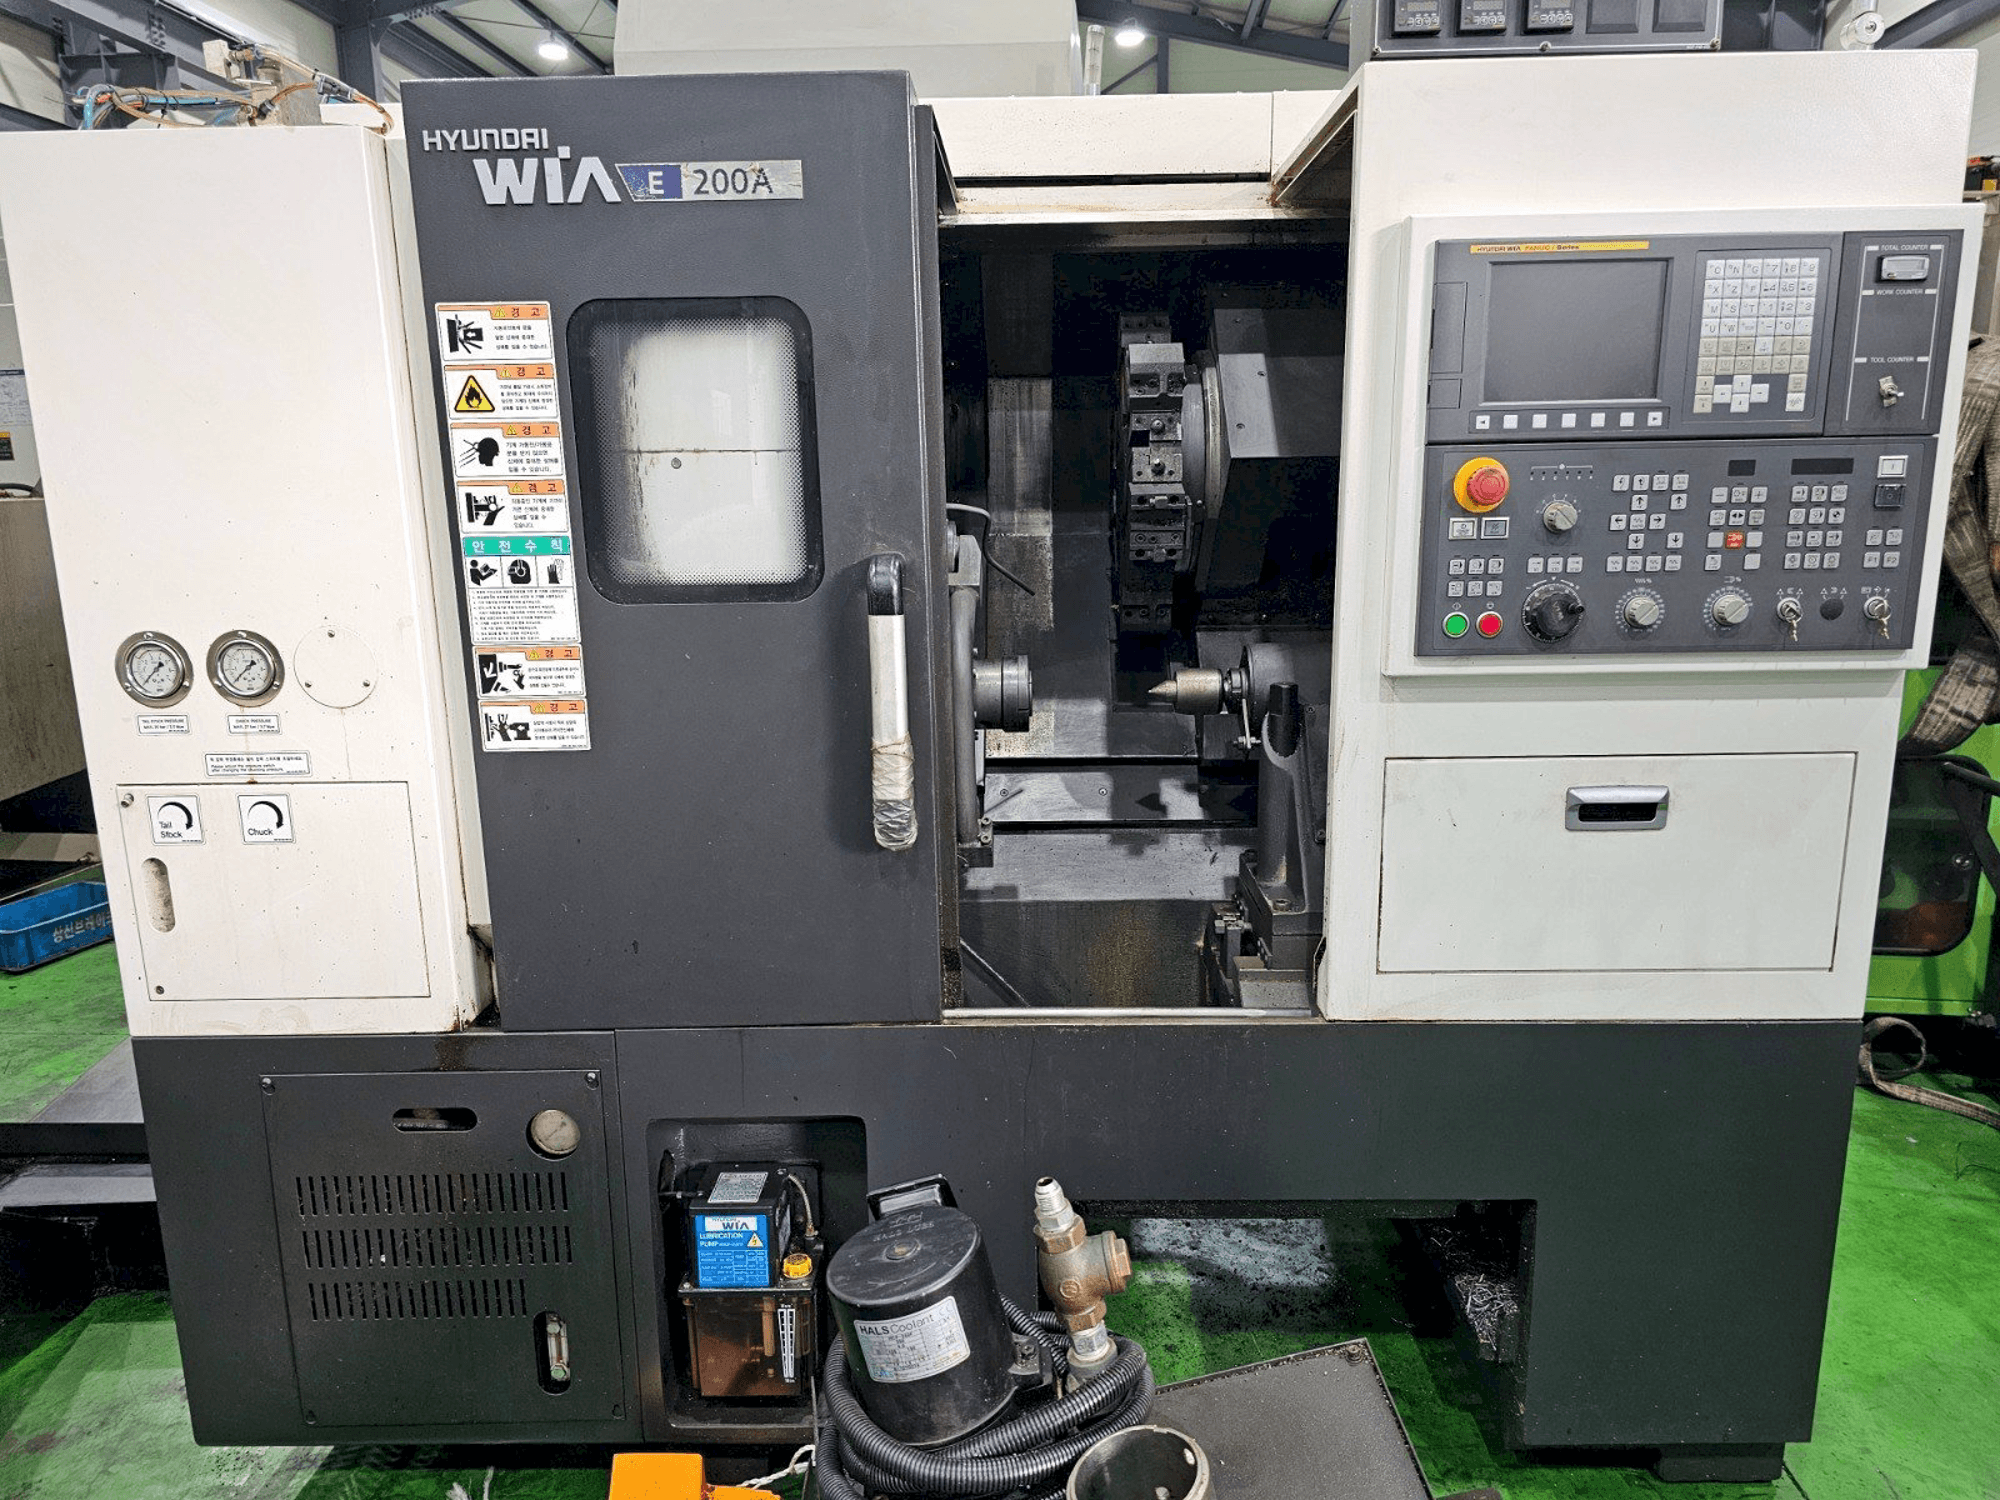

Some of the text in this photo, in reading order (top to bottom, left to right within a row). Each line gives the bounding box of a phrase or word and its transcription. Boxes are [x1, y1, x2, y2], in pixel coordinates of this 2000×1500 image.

[422, 128, 549, 151] HYUNDAI
[472, 145, 622, 205] WIA
[647, 167, 774, 195] E 200A
[158, 821, 172, 829] Tail
[247, 828, 273, 836] Chuck
[160, 830, 183, 838] Stock
[722, 1219, 750, 1230] WIA
[859, 1314, 935, 1336] HALS Coolant
